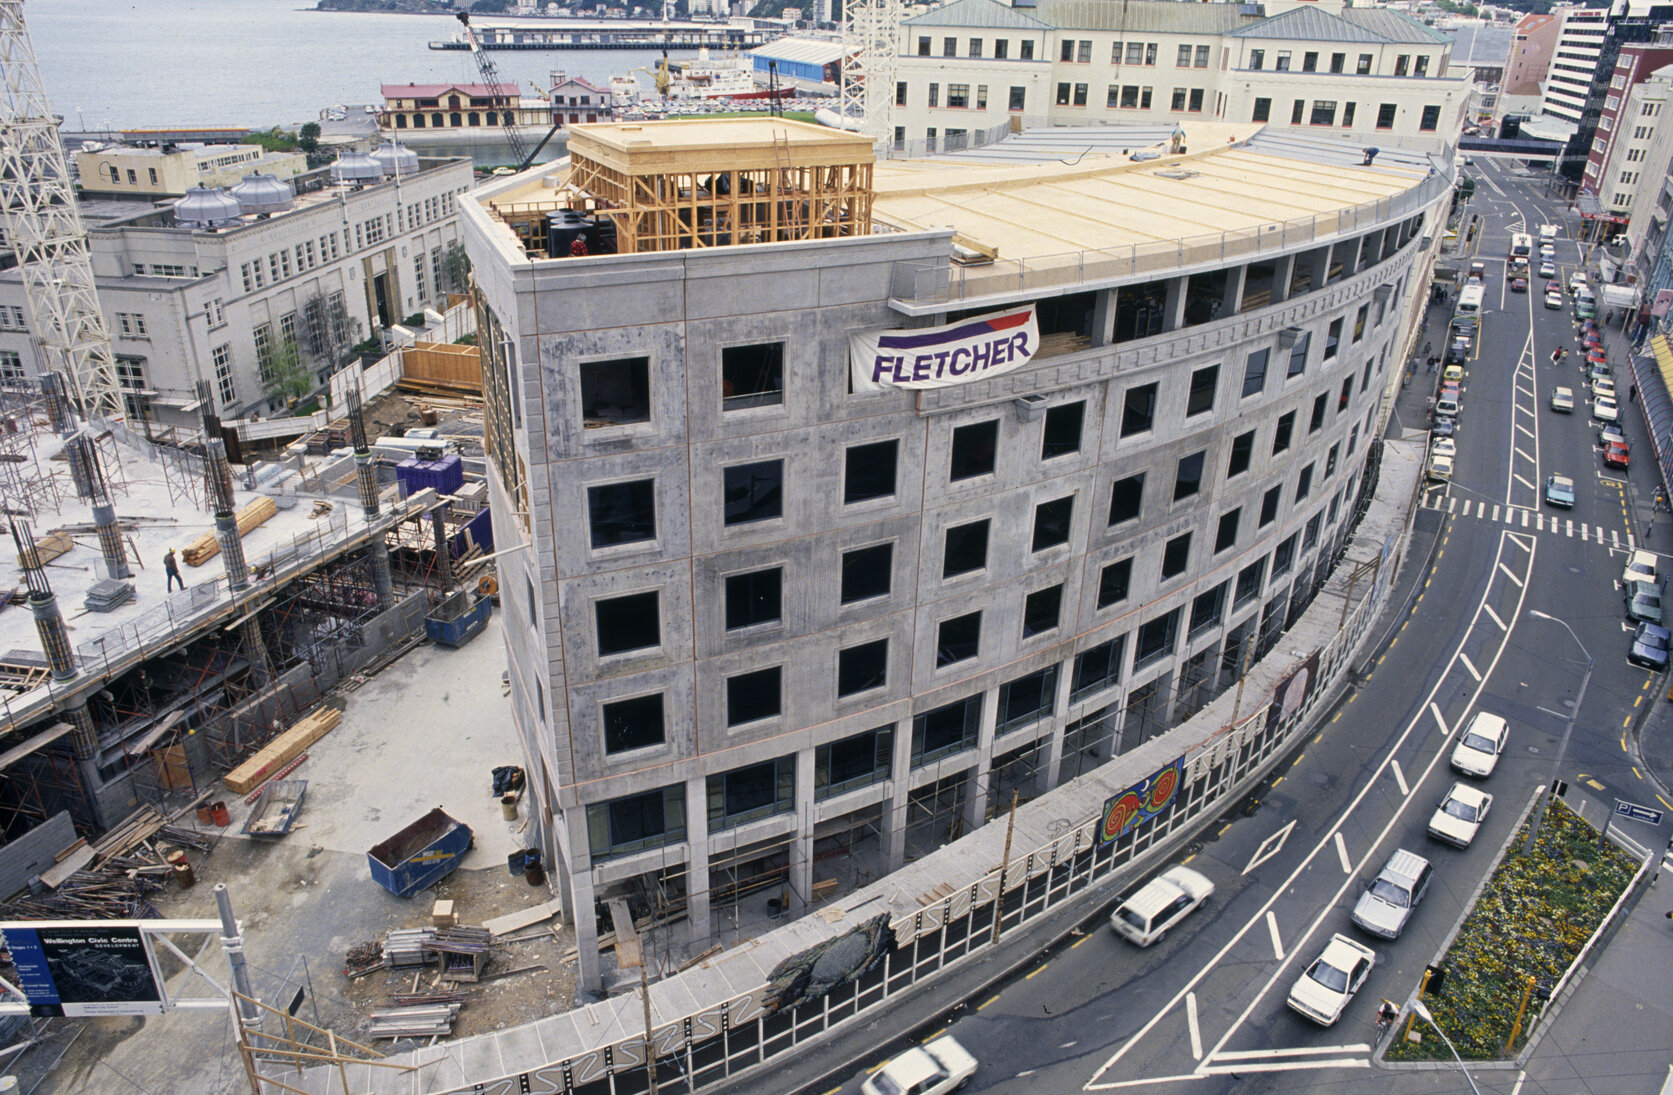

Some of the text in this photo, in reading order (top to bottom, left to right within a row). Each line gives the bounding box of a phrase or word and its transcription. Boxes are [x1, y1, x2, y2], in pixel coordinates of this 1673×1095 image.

[871, 331, 1031, 383] FLETCHER
[1618, 803, 1628, 811] P
[43, 936, 138, 945] Wellington Civic Centre
